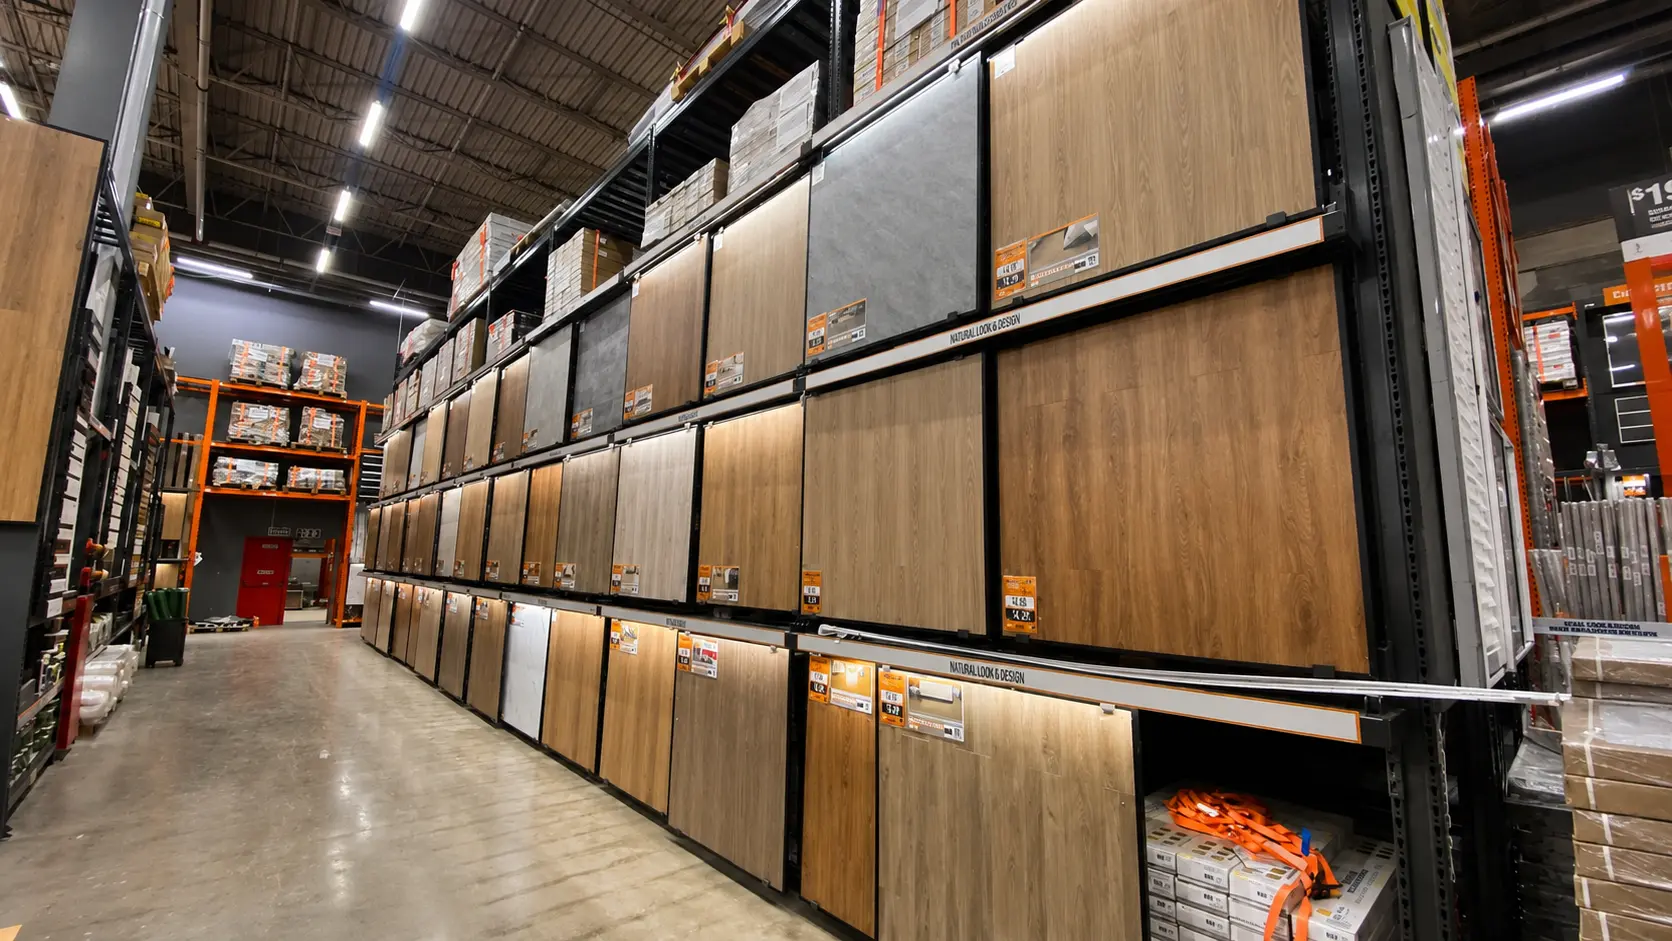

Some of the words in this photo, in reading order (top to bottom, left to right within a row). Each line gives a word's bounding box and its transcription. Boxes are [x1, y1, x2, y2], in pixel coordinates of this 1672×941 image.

[949, 327, 976, 344] NATURAL
[976, 323, 992, 336] LOOK
[998, 313, 1020, 329] DESIGN
[949, 661, 977, 676] NATURAL
[977, 665, 994, 679] LOOK
[1000, 669, 1025, 684] DESIGN
